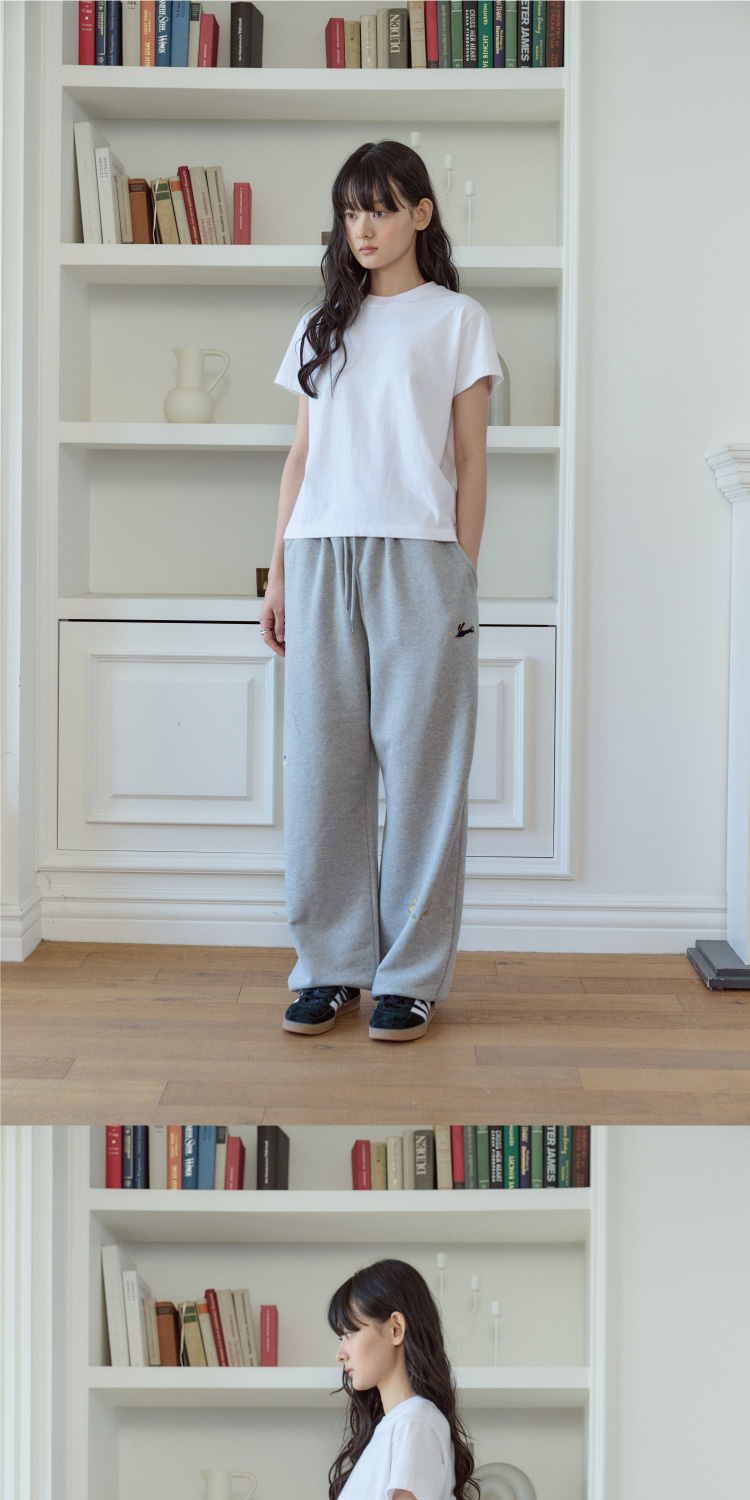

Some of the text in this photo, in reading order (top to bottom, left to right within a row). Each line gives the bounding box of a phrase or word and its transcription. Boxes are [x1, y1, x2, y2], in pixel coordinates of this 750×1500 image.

[158, 34, 168, 54] WINGS
[390, 14, 400, 54] DUDEN
[520, 26, 530, 62] JAMES
[416, 1135, 426, 1176] DUDEN
[546, 1147, 556, 1182] JAMES
